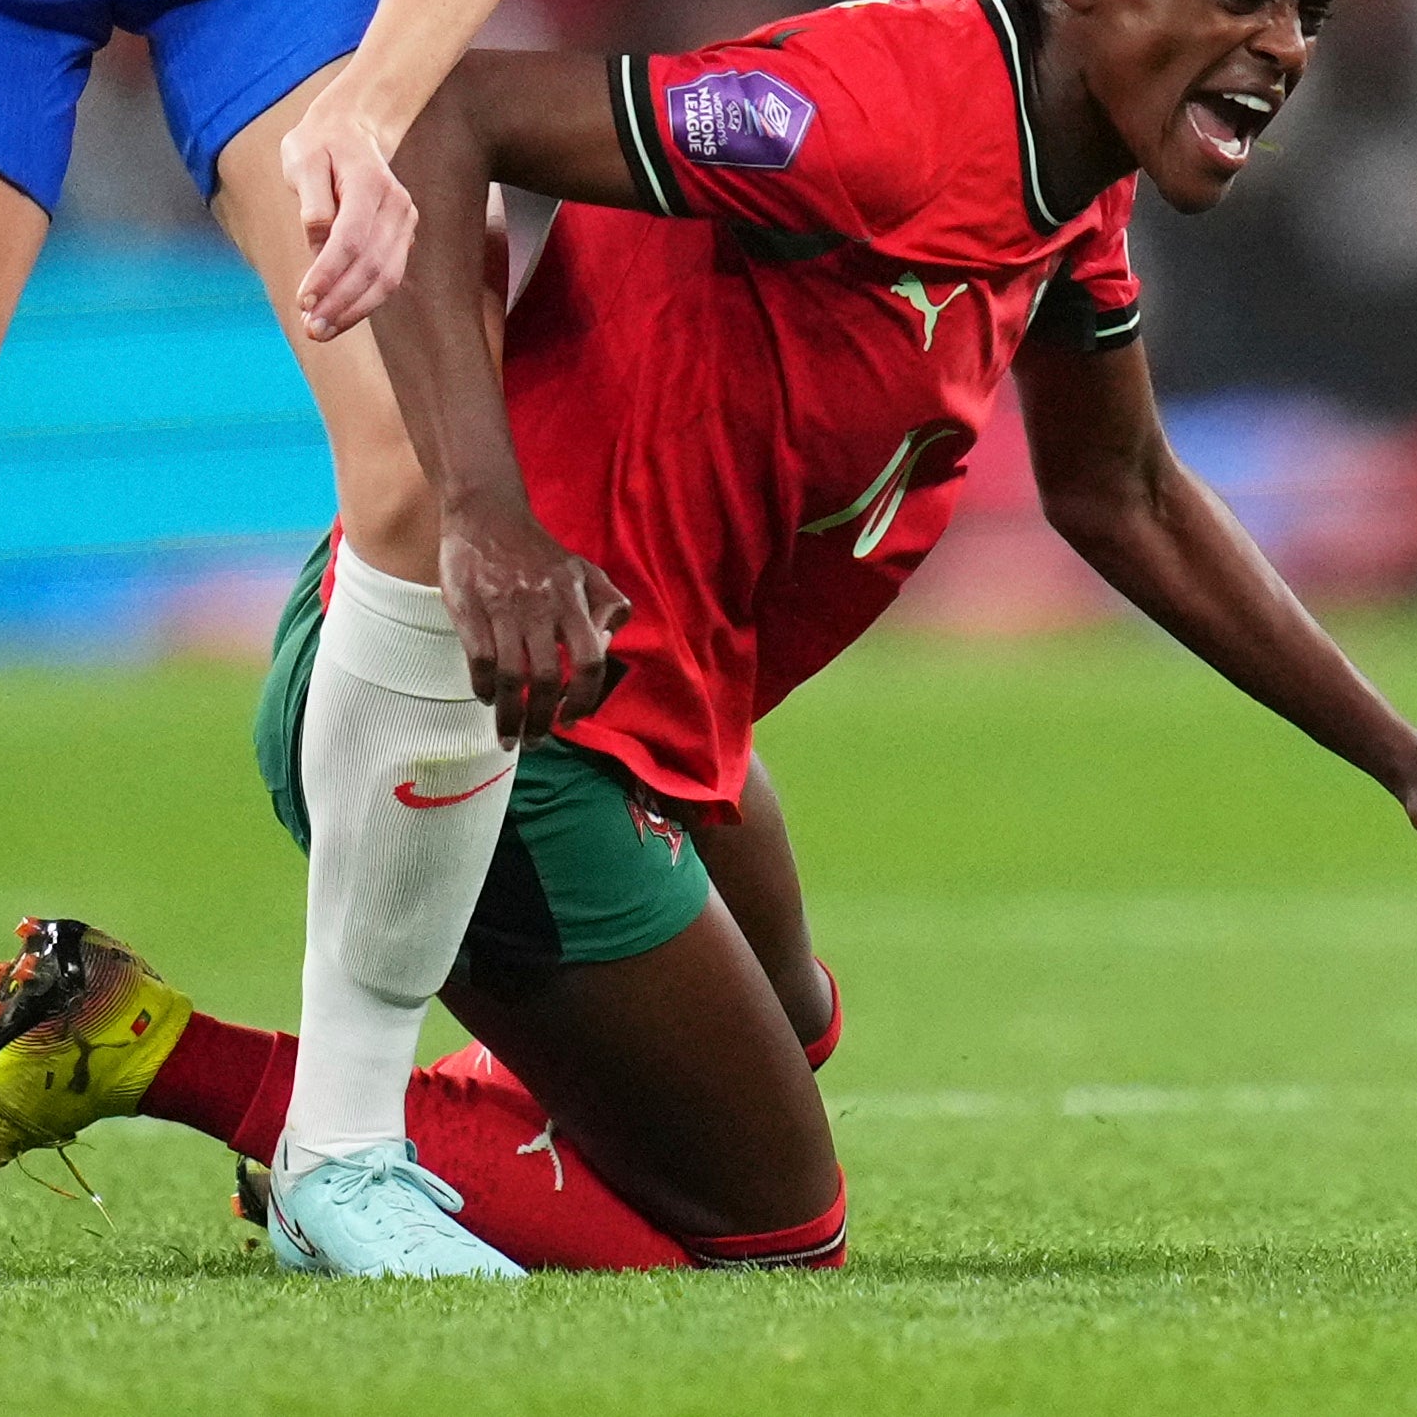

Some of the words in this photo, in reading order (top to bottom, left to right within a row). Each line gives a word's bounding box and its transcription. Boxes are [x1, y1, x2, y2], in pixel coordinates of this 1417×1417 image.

[684, 93, 702, 153] LEAGUE
[698, 86, 717, 156] NATIONS
[712, 91, 728, 147] women's
